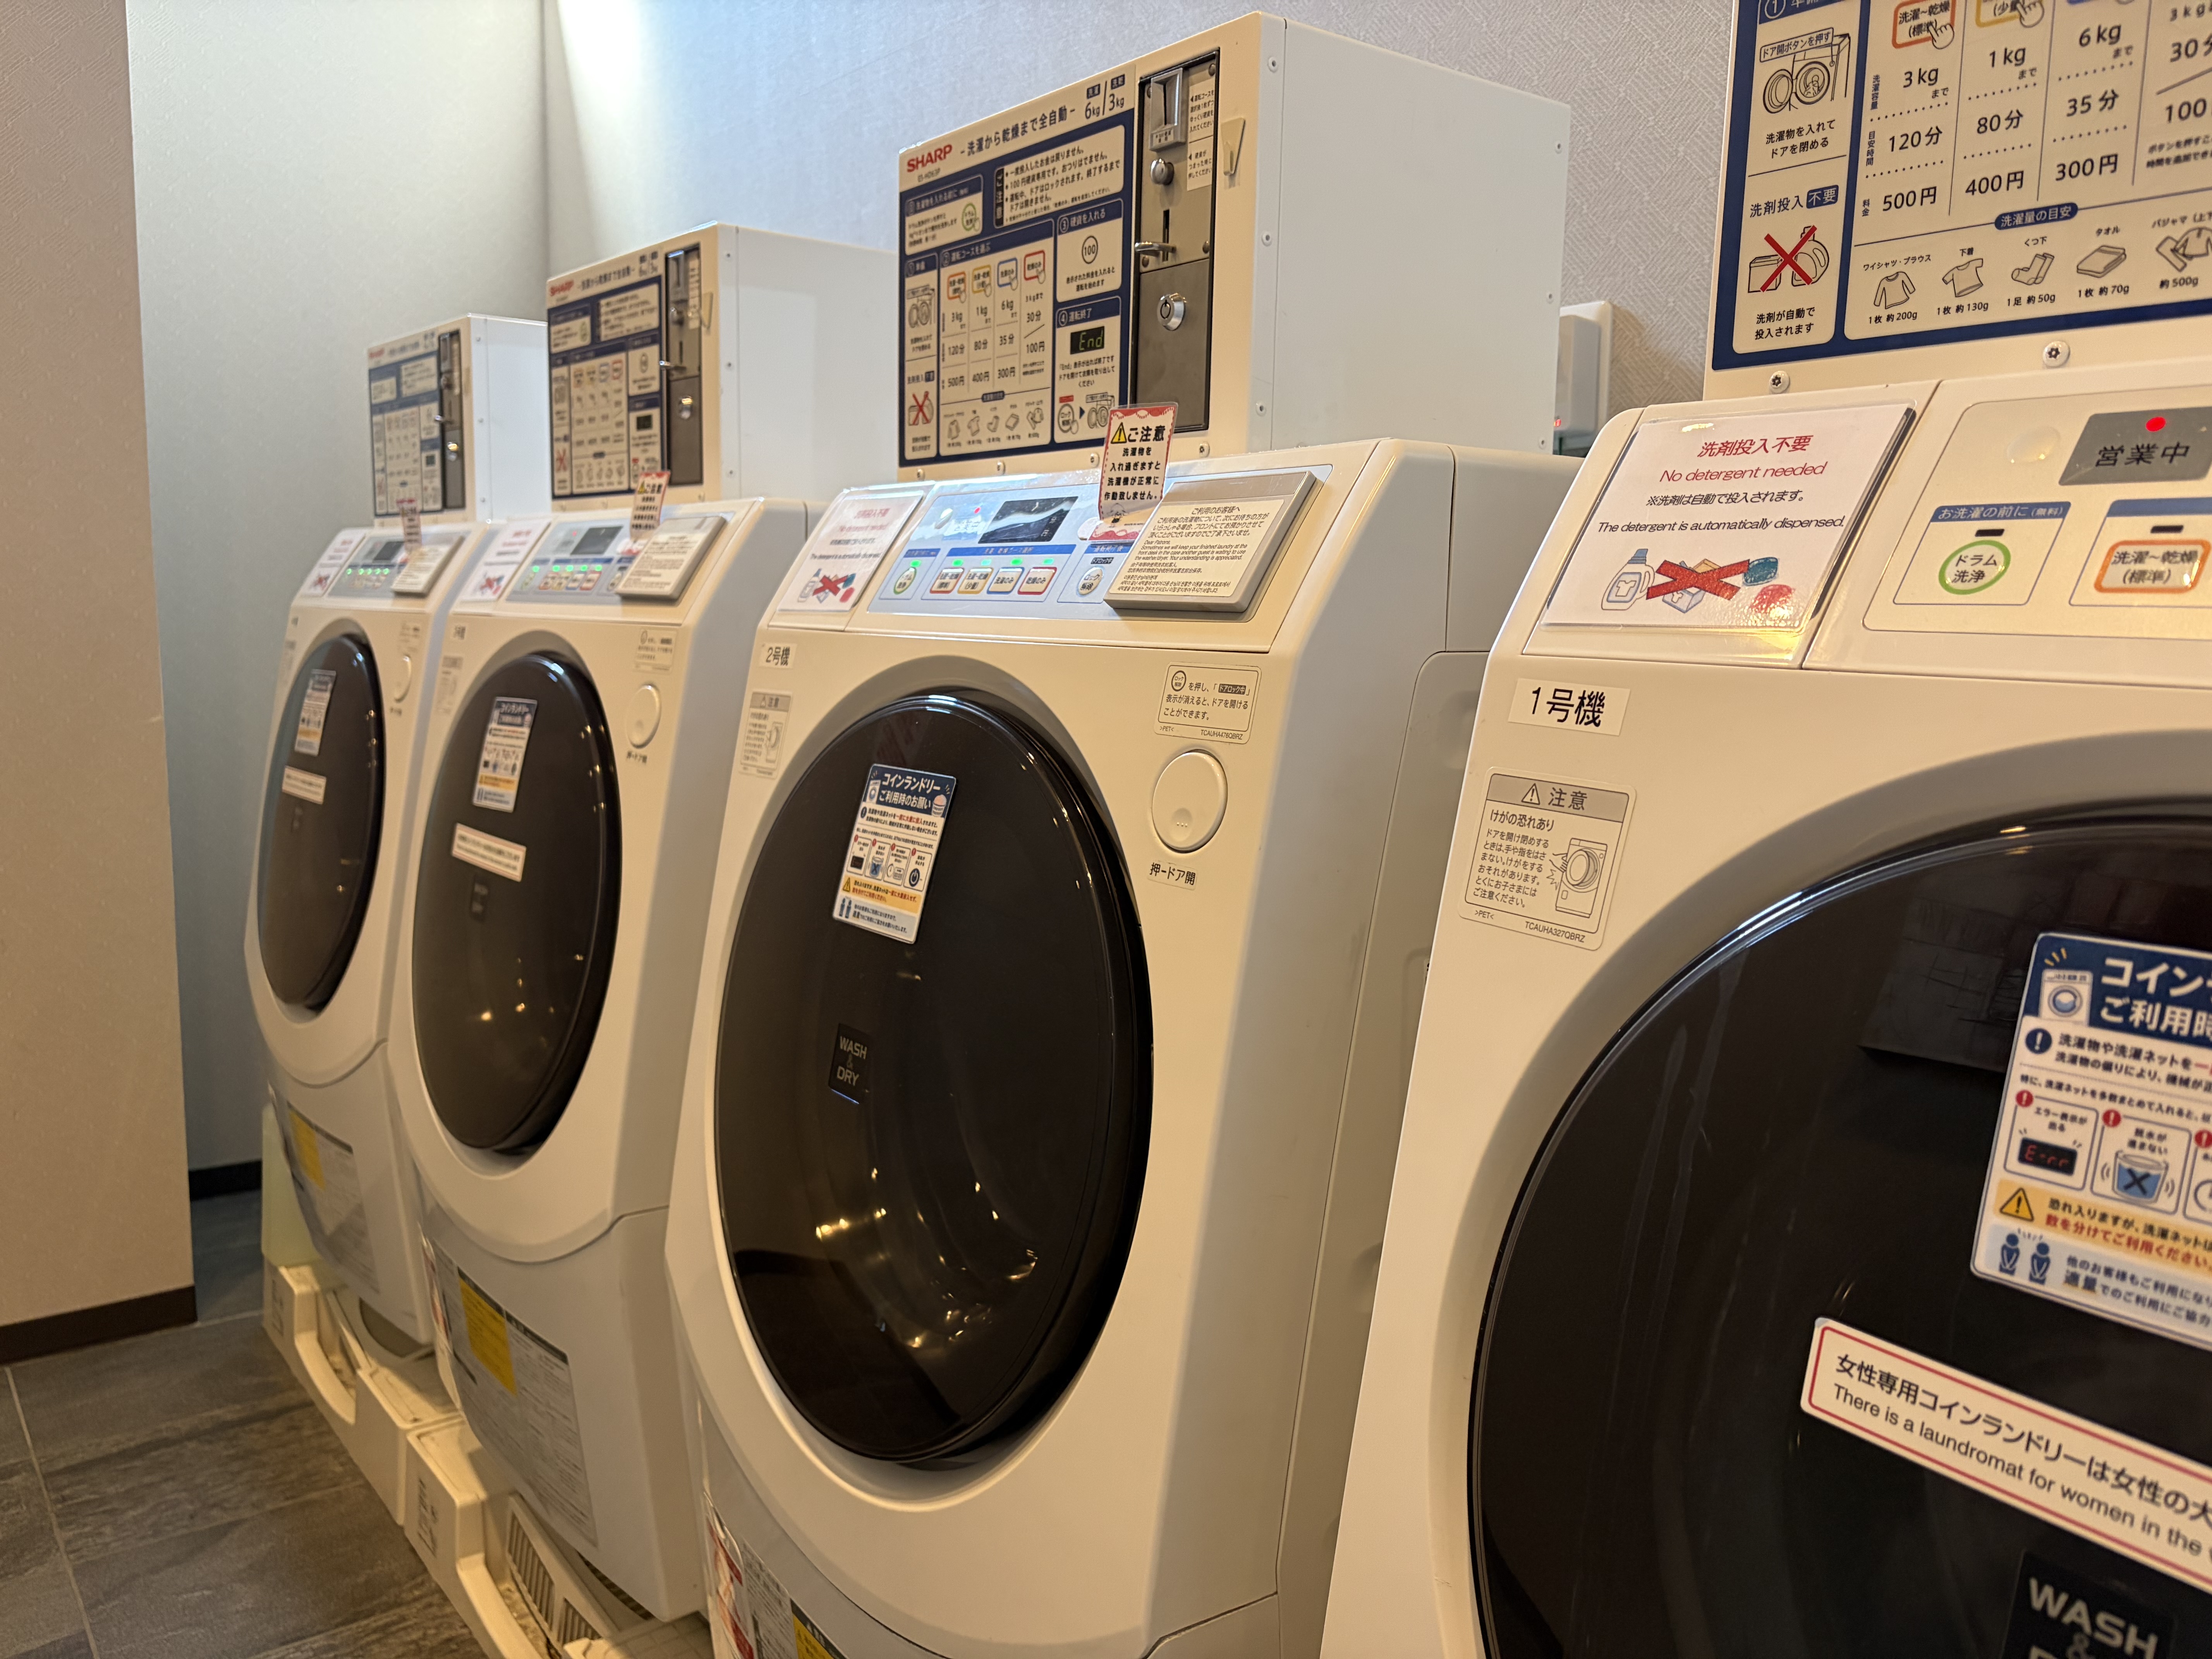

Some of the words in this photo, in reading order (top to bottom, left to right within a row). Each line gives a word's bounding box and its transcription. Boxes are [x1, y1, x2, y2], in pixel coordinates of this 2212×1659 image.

[1763, 31, 1831, 58] ドア開ボタンを押す
[2113, 45, 2133, 59] まで
[2018, 67, 2037, 80] まで
[1932, 88, 1949, 99] まで
[2066, 89, 2119, 117] 35分
[1085, 102, 1100, 119] 6kg
[1109, 93, 1124, 111] 3kg
[1977, 109, 2024, 134] 80分
[1766, 119, 1836, 145] 洗濯物を入れて
[1889, 126, 1942, 153] 120分
[907, 144, 952, 172] SHARP
[1771, 137, 1829, 159] ドアを閉める
[1866, 131, 1875, 166] 目安時間
[2056, 154, 2119, 181] 300円
[1965, 170, 2024, 196] 400円
[1750, 196, 1803, 218] 洗剤投入
[1808, 187, 1837, 206] 不要
[1862, 199, 1870, 216] 料金
[1882, 186, 1937, 212] 500円
[2001, 206, 2072, 227] 洗濯量の目安
[2024, 236, 2047, 246] くつ下
[2096, 226, 2120, 236] タオル
[1085, 244, 1096, 256] 100
[1959, 247, 1974, 256] 下着
[1756, 307, 1815, 325] 洗剤が自動で
[1079, 328, 1103, 351] End
[1755, 323, 1814, 340] 投入されます
[1128, 426, 1165, 442] ご注意
[1123, 447, 1152, 457] 洗濯物を
[1697, 435, 1813, 458] 洗剤投入不要
[2095, 441, 2191, 467] 営業中
[1110, 461, 1161, 472] 入れ過ぎますと
[1659, 470, 1682, 483] No
[1686, 467, 1761, 482] detergent
[1763, 462, 1828, 477] needed
[1108, 476, 1159, 486] 洗濯機が正常に
[1104, 491, 1158, 501] 作動致しません。
[1192, 506, 1240, 515] ご利用のお客様へ
[1938, 505, 2028, 520] お洗濯の前に
[1598, 522, 1619, 533] The
[1621, 521, 1676, 534] detergent
[1678, 522, 1688, 531] is
[1690, 518, 1772, 532] automatically
[1774, 515, 1845, 530] dispensed.
[1954, 554, 1997, 567] ドラム
[1953, 569, 1985, 584] 洗浄
[766, 646, 790, 666] 2号機
[1166, 694, 1249, 709] 表示が消えると、ドアを開ける
[1531, 687, 1606, 727] 1号機
[1163, 707, 1210, 721] ことができます。
[882, 773, 941, 793] コインランドリー
[879, 790, 931, 809] ご利用時のお願い
[1548, 787, 1588, 811] 注意
[1490, 809, 1554, 832] けがの恐れあり
[1486, 828, 1549, 848] ドアを開け閉めする
[1483, 841, 1547, 861] ときは、手や指をはさ
[1480, 853, 1543, 873] まない。けがをする
[1477, 864, 1540, 886] おそれがあります。
[1475, 876, 1537, 897] とくにお子さまには
[1473, 888, 1525, 908] ご注意ください。
[1525, 921, 1586, 943] TCAUHA327QBRZ
[2101, 957, 2212, 998] コイン
[840, 1036, 867, 1060] WASH
[836, 1066, 860, 1086] DRY
[1834, 1383, 1880, 1418] There
[1884, 1406, 1900, 1425] is
[1903, 1418, 1915, 1433] a
[1919, 1420, 2025, 1481] laundromat
[2028, 1465, 2056, 1492] for
[2060, 1485, 2135, 1528] women
[2141, 1515, 2160, 1540] in
[2167, 1528, 2202, 1556] the
[2029, 1576, 2158, 1659] WASH
